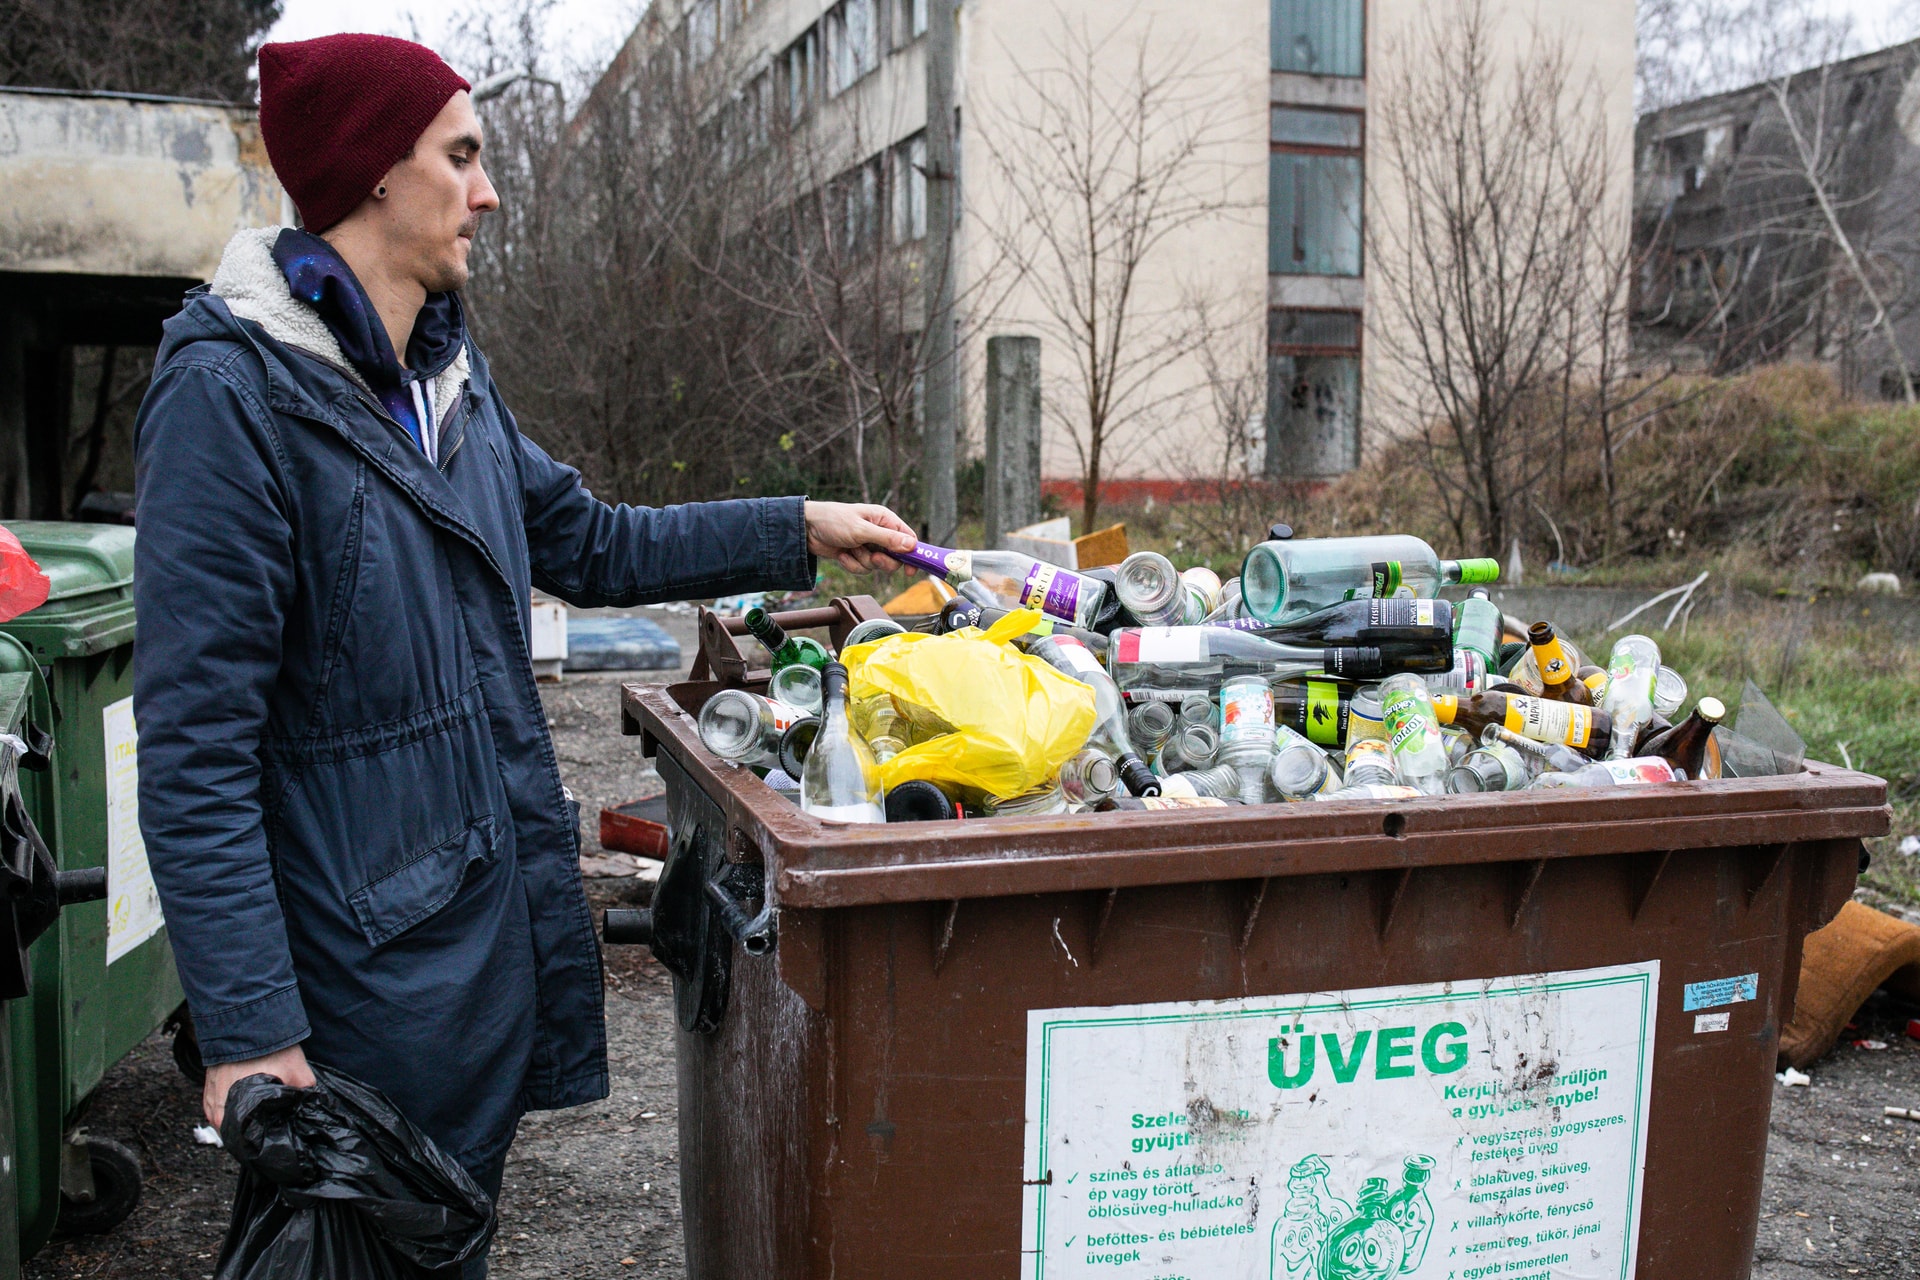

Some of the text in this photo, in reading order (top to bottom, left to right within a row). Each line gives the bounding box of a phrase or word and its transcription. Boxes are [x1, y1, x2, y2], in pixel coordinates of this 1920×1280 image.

[1268, 1021, 1469, 1089] ÜVEG
[1452, 1107, 1463, 1119] a
[1142, 1166, 1160, 1179] és
[1088, 1181, 1194, 1203] ép vagy törött
[1158, 1229, 1176, 1242] és
[1180, 1223, 1255, 1240] bébiételes
[1086, 1249, 1141, 1265] üvegek
[1463, 1253, 1569, 1280] egyéb ismeretlen
